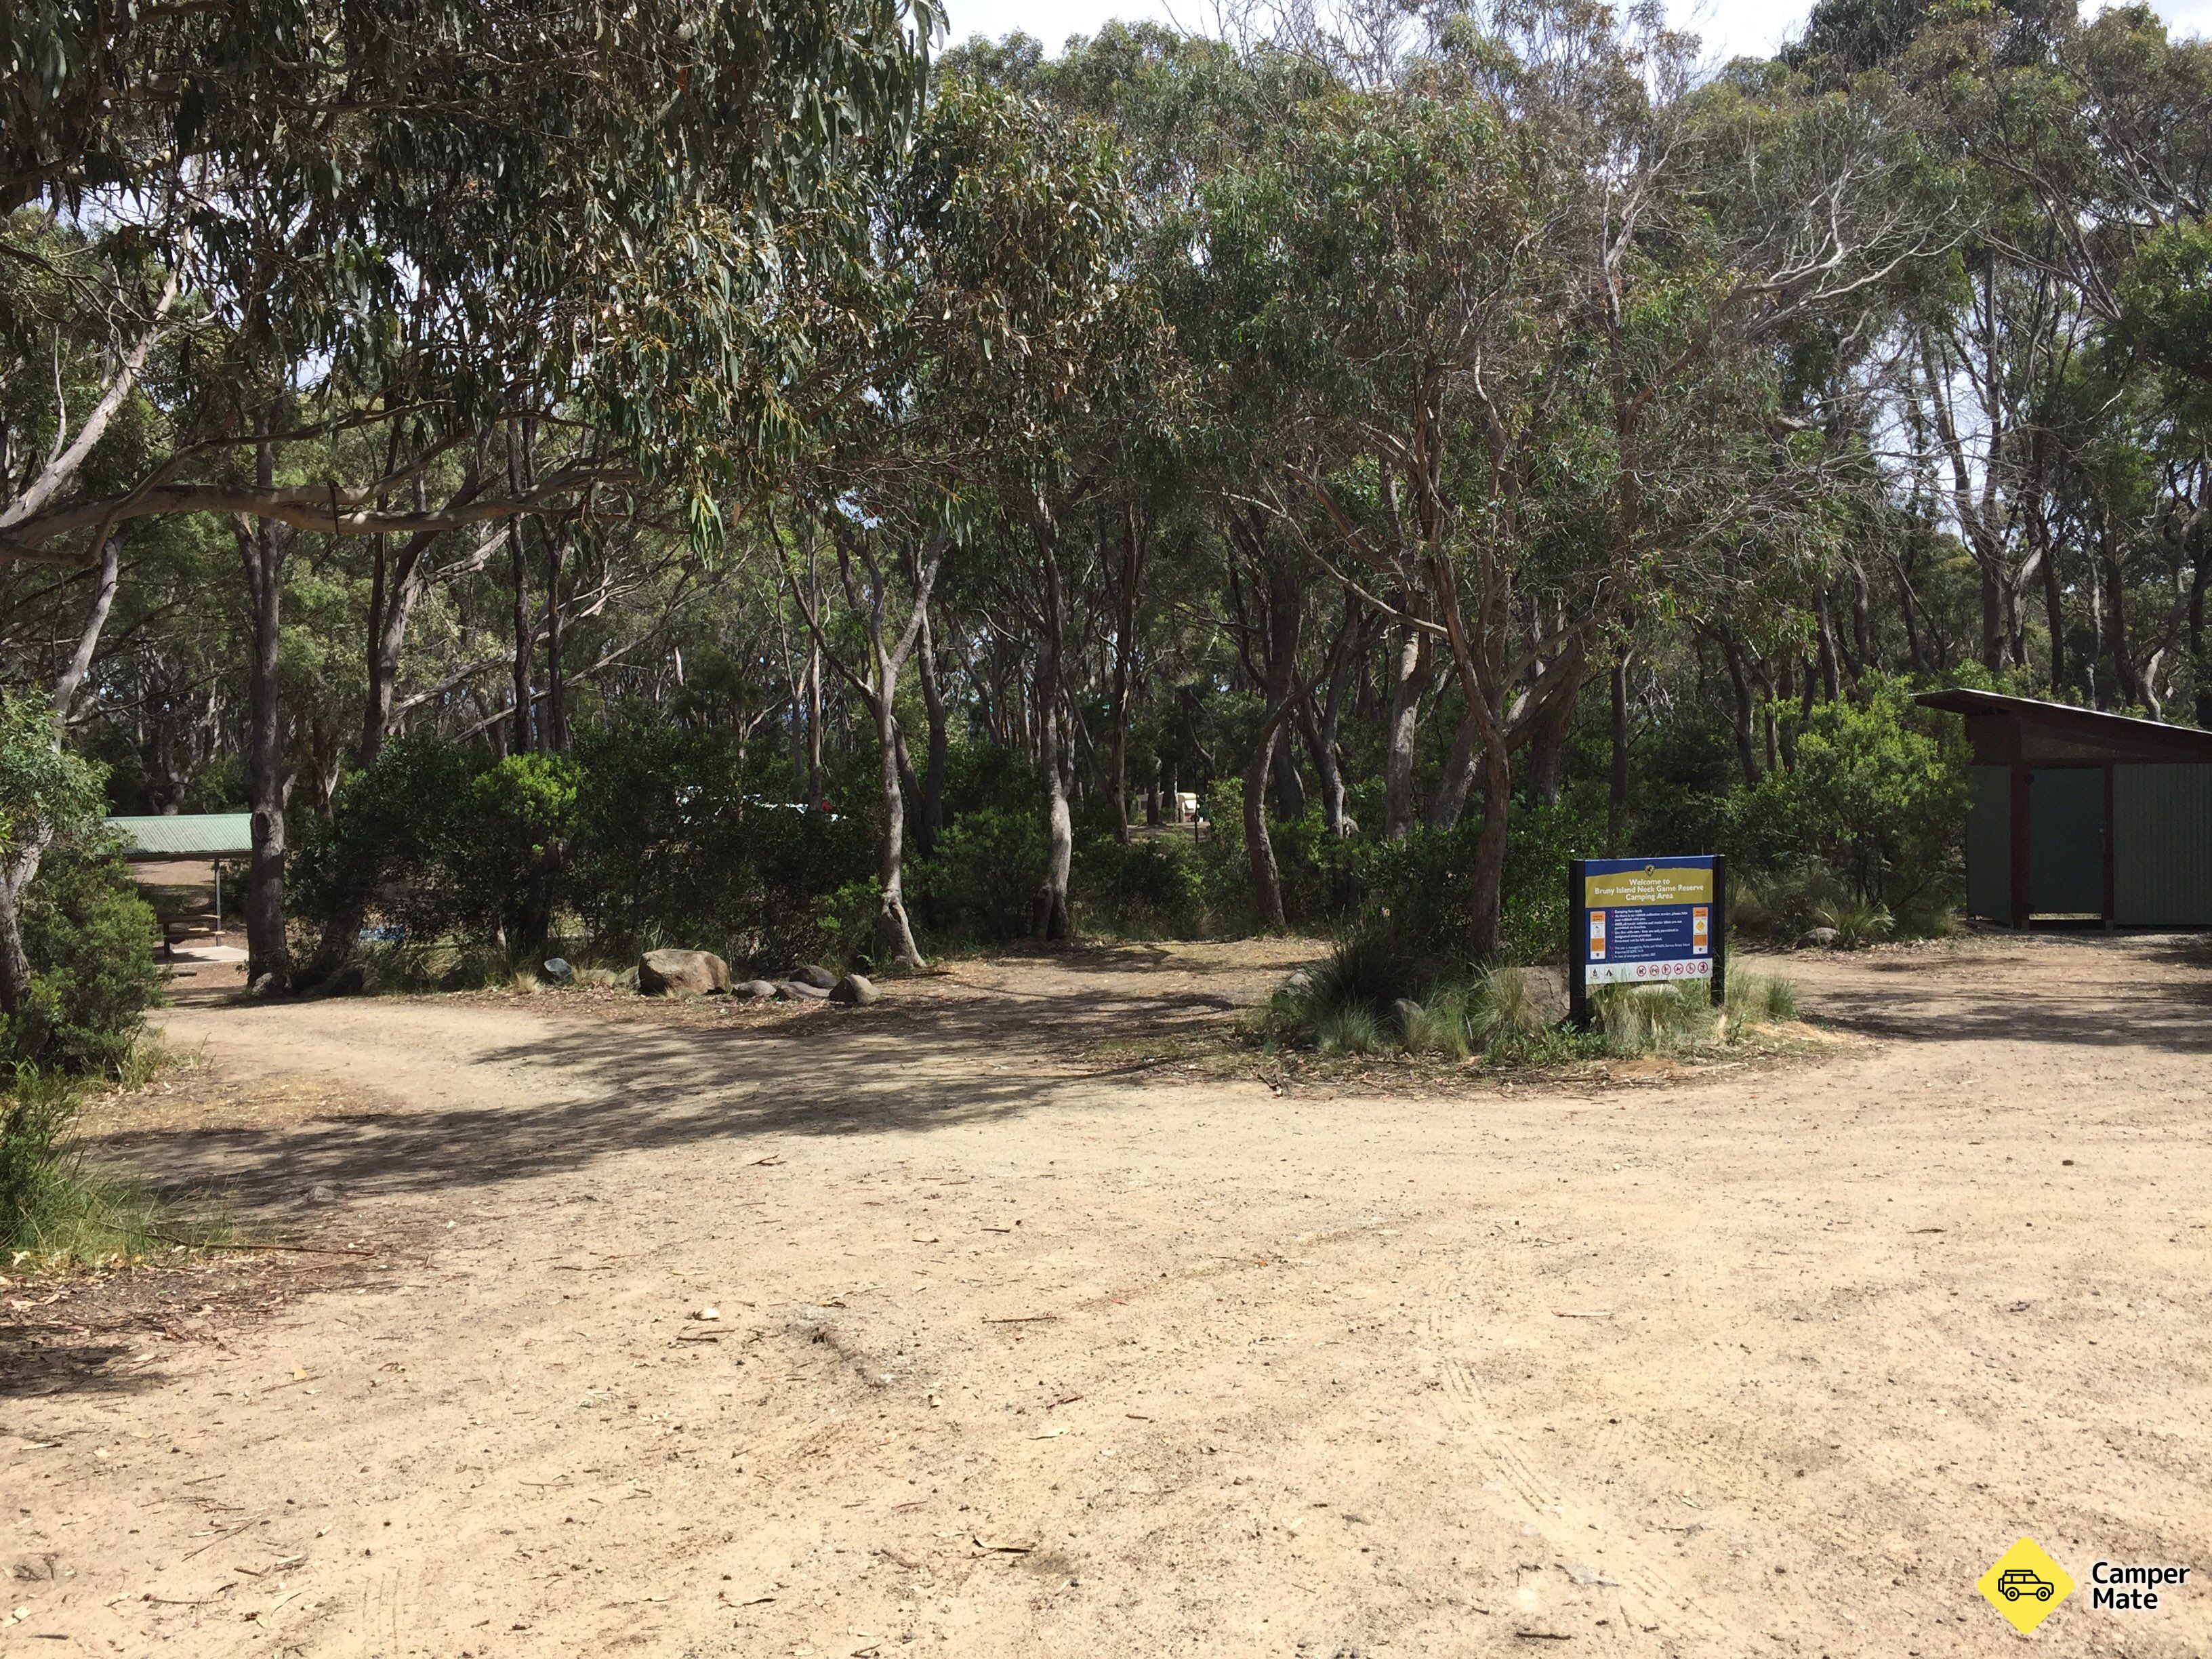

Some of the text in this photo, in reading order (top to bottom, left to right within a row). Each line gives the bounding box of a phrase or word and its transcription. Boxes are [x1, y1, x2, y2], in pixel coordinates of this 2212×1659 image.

[1595, 887, 1614, 896] Bruny
[1637, 885, 1655, 893] Neck
[1625, 893, 1656, 902] Camping
